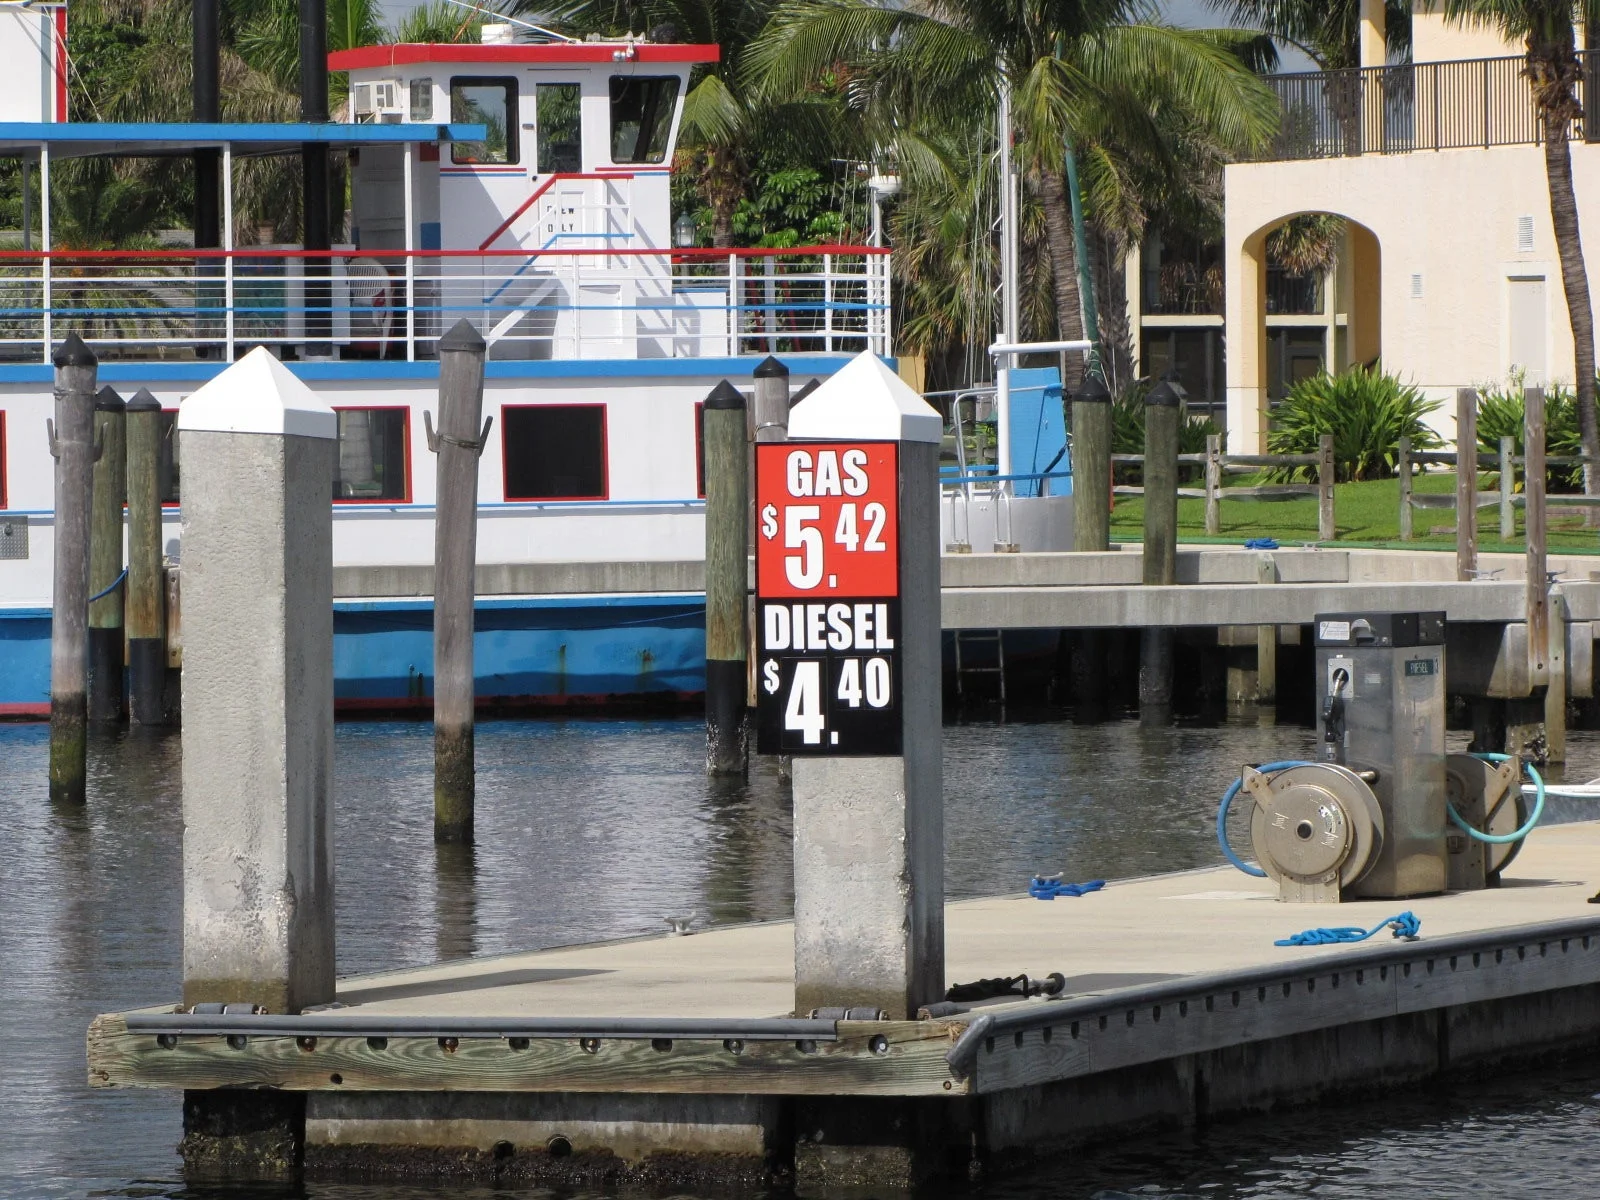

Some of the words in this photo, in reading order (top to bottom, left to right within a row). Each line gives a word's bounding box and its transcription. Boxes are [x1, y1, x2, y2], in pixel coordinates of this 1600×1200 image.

[547, 223, 574, 233] OLY
[786, 449, 869, 497] GAS
[764, 603, 894, 651] DIESEL
